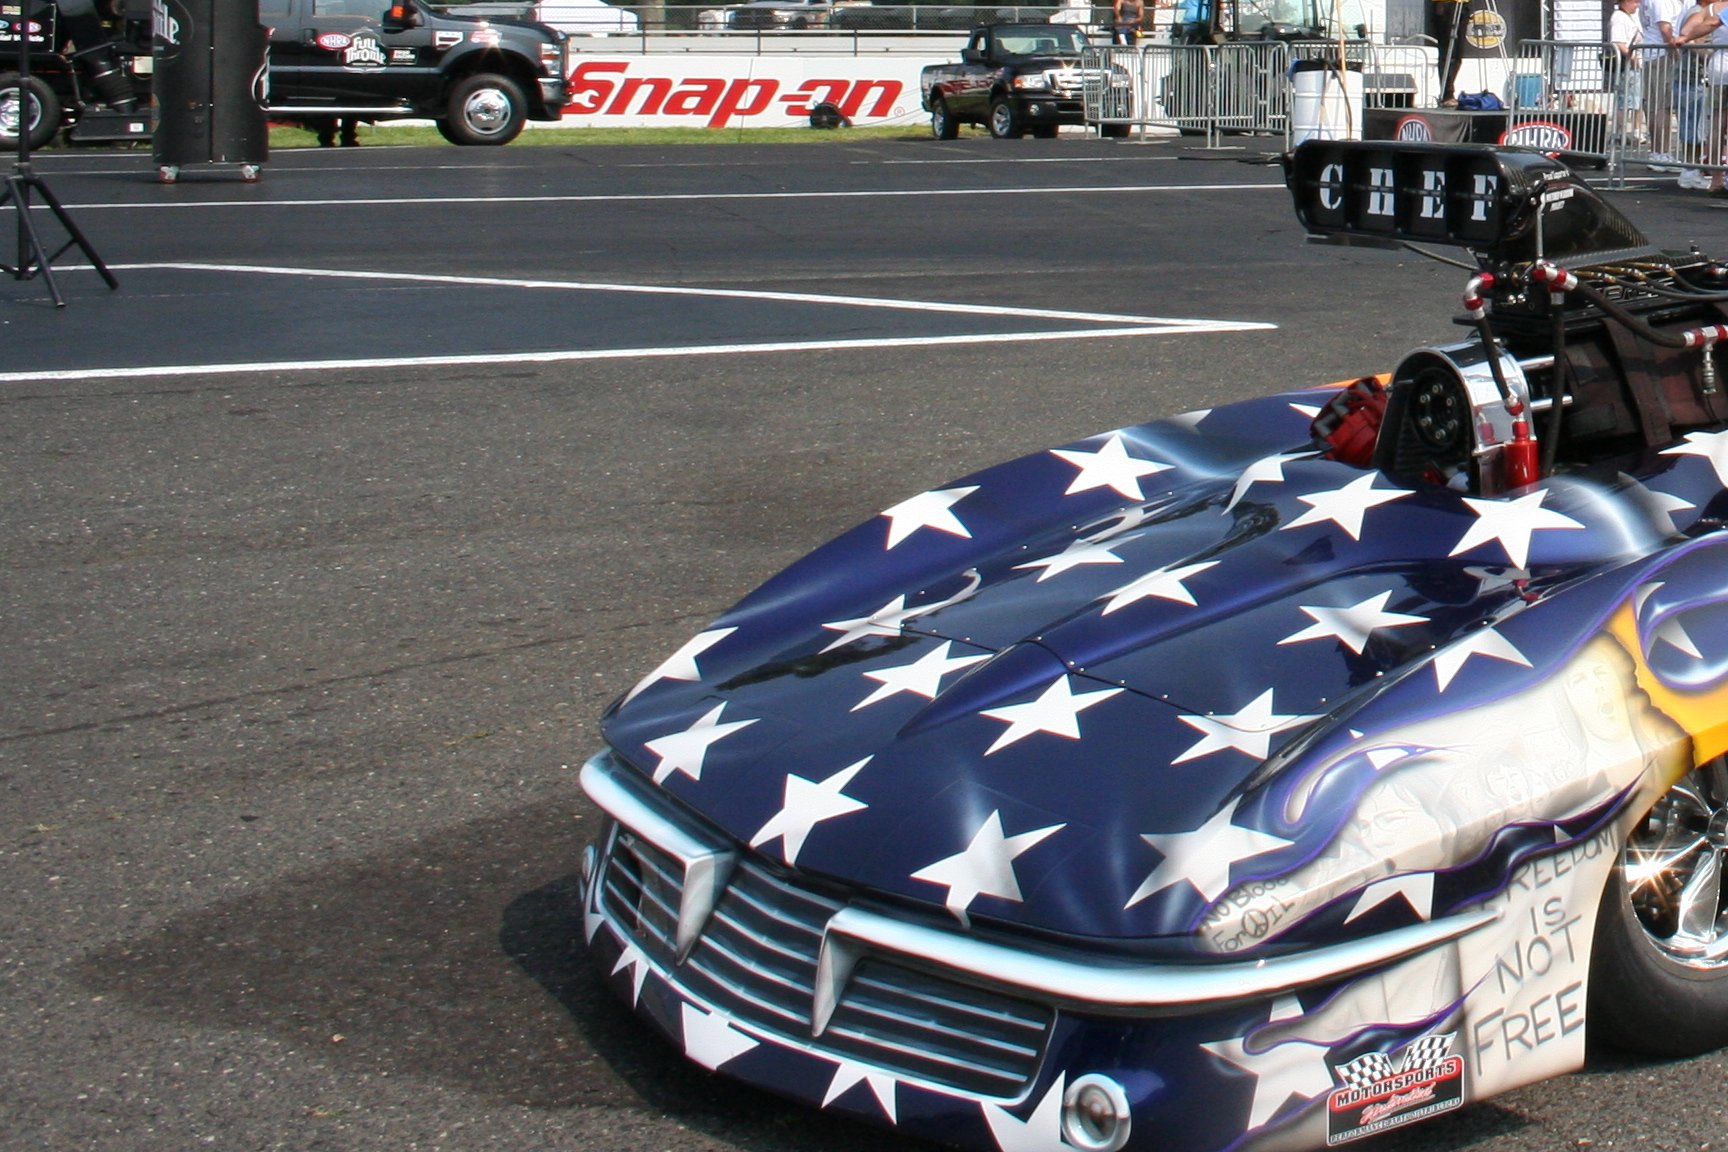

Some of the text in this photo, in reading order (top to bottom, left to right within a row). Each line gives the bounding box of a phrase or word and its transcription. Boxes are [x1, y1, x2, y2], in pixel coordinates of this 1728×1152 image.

[562, 62, 903, 128] Snap-on
[1483, 825, 1616, 909] REEDOM
[1531, 897, 1566, 935] IS
[1496, 914, 1582, 994] NOT
[1474, 980, 1585, 1076] FREE
[1336, 1061, 1456, 1107] MOTORSPORTS
